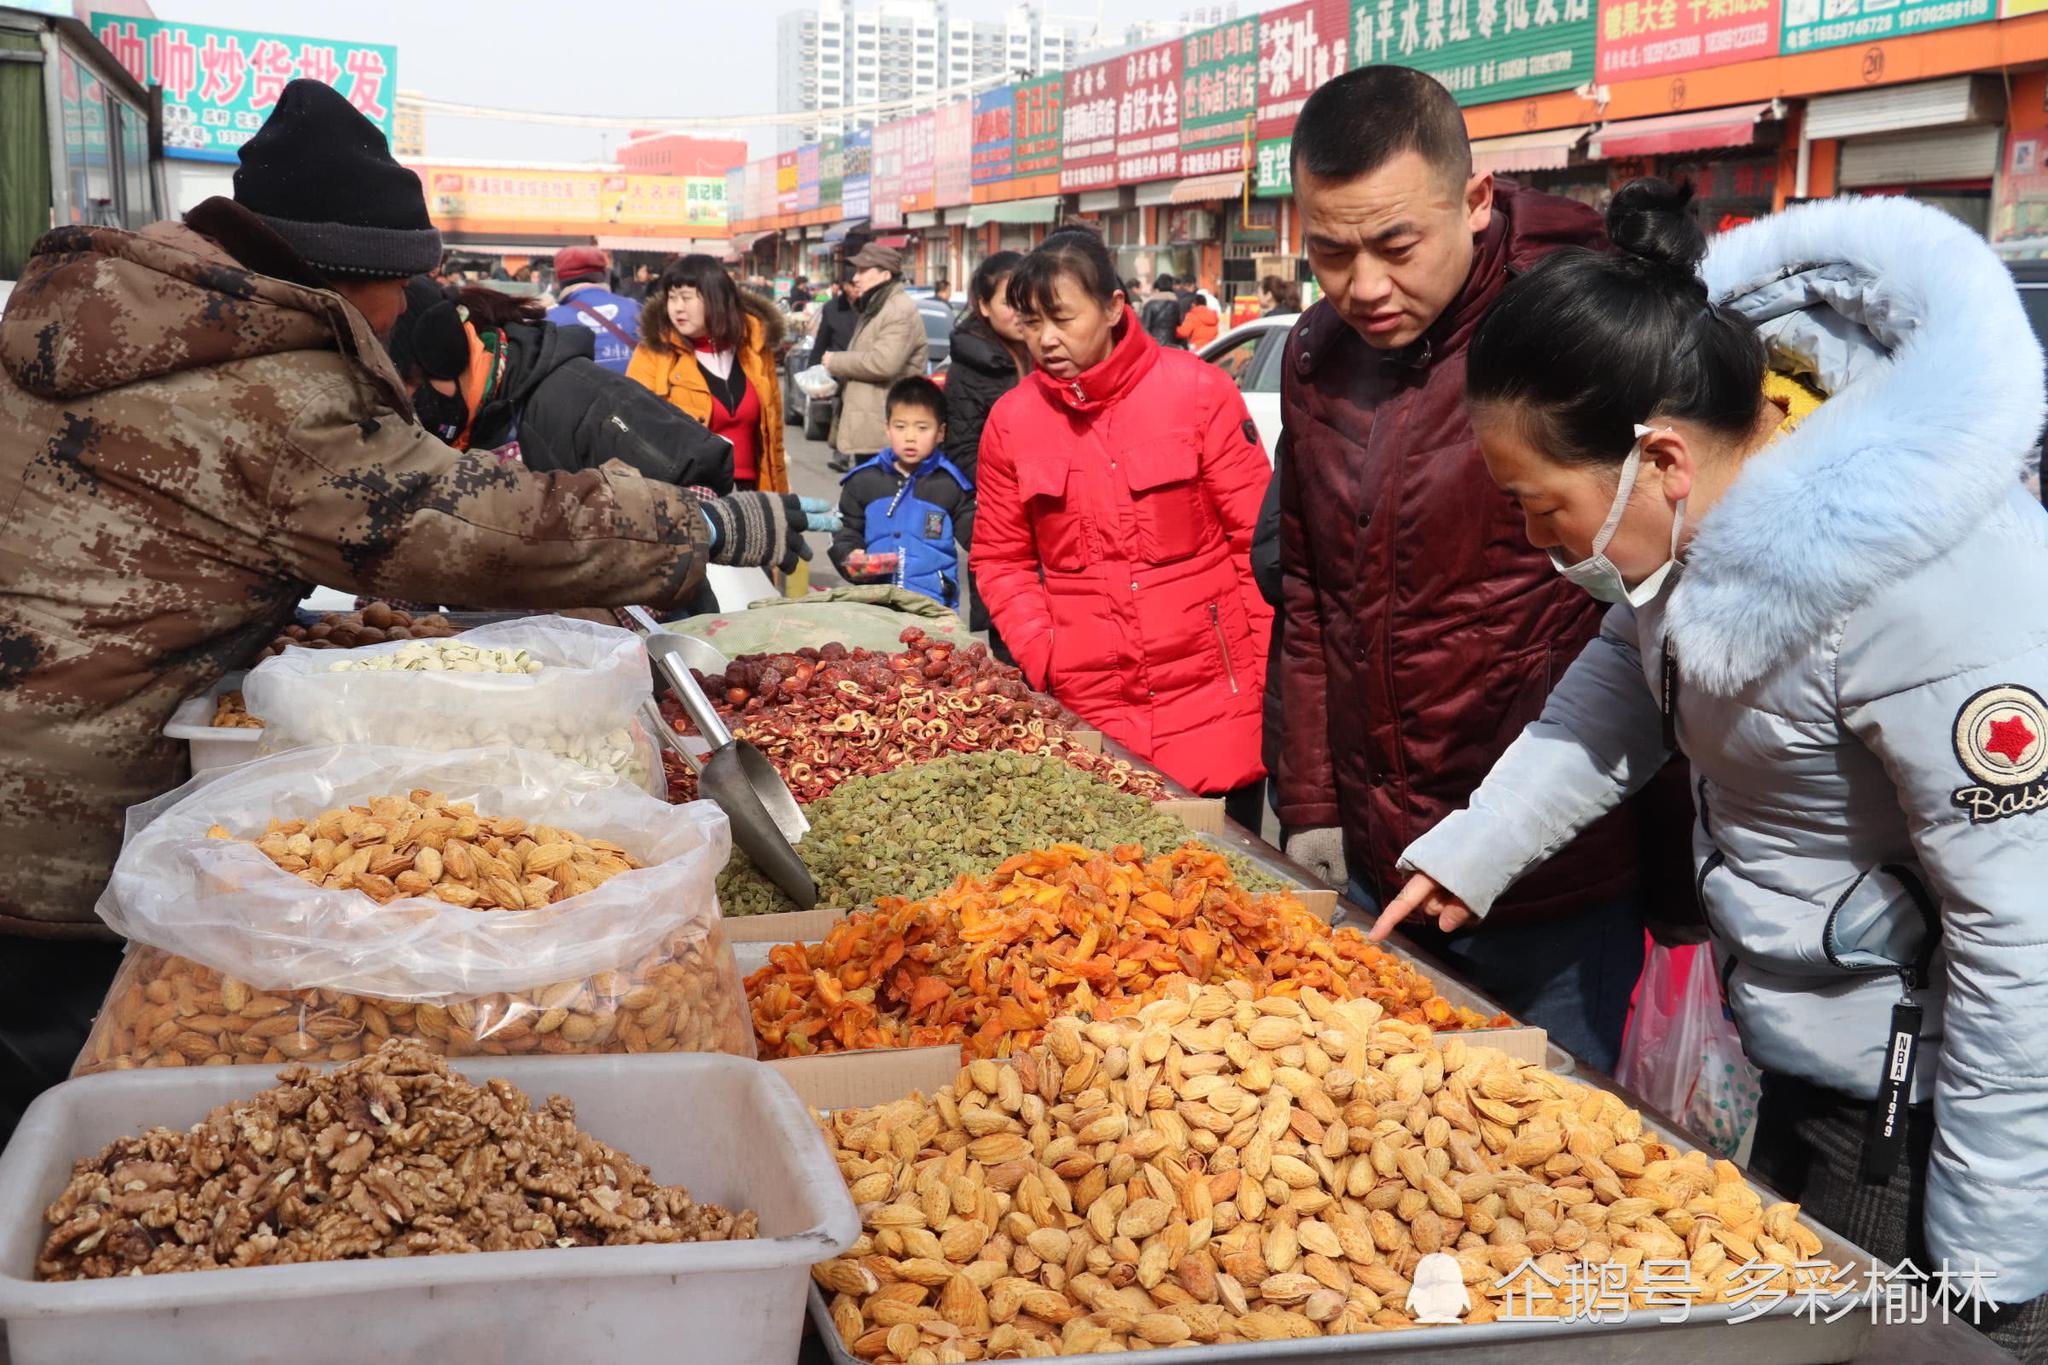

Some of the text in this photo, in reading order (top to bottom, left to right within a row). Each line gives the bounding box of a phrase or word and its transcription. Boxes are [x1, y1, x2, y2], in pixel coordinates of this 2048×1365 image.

[1604, 0, 1678, 41] 糖果大全
[1118, 80, 1178, 136] 卤货大全
